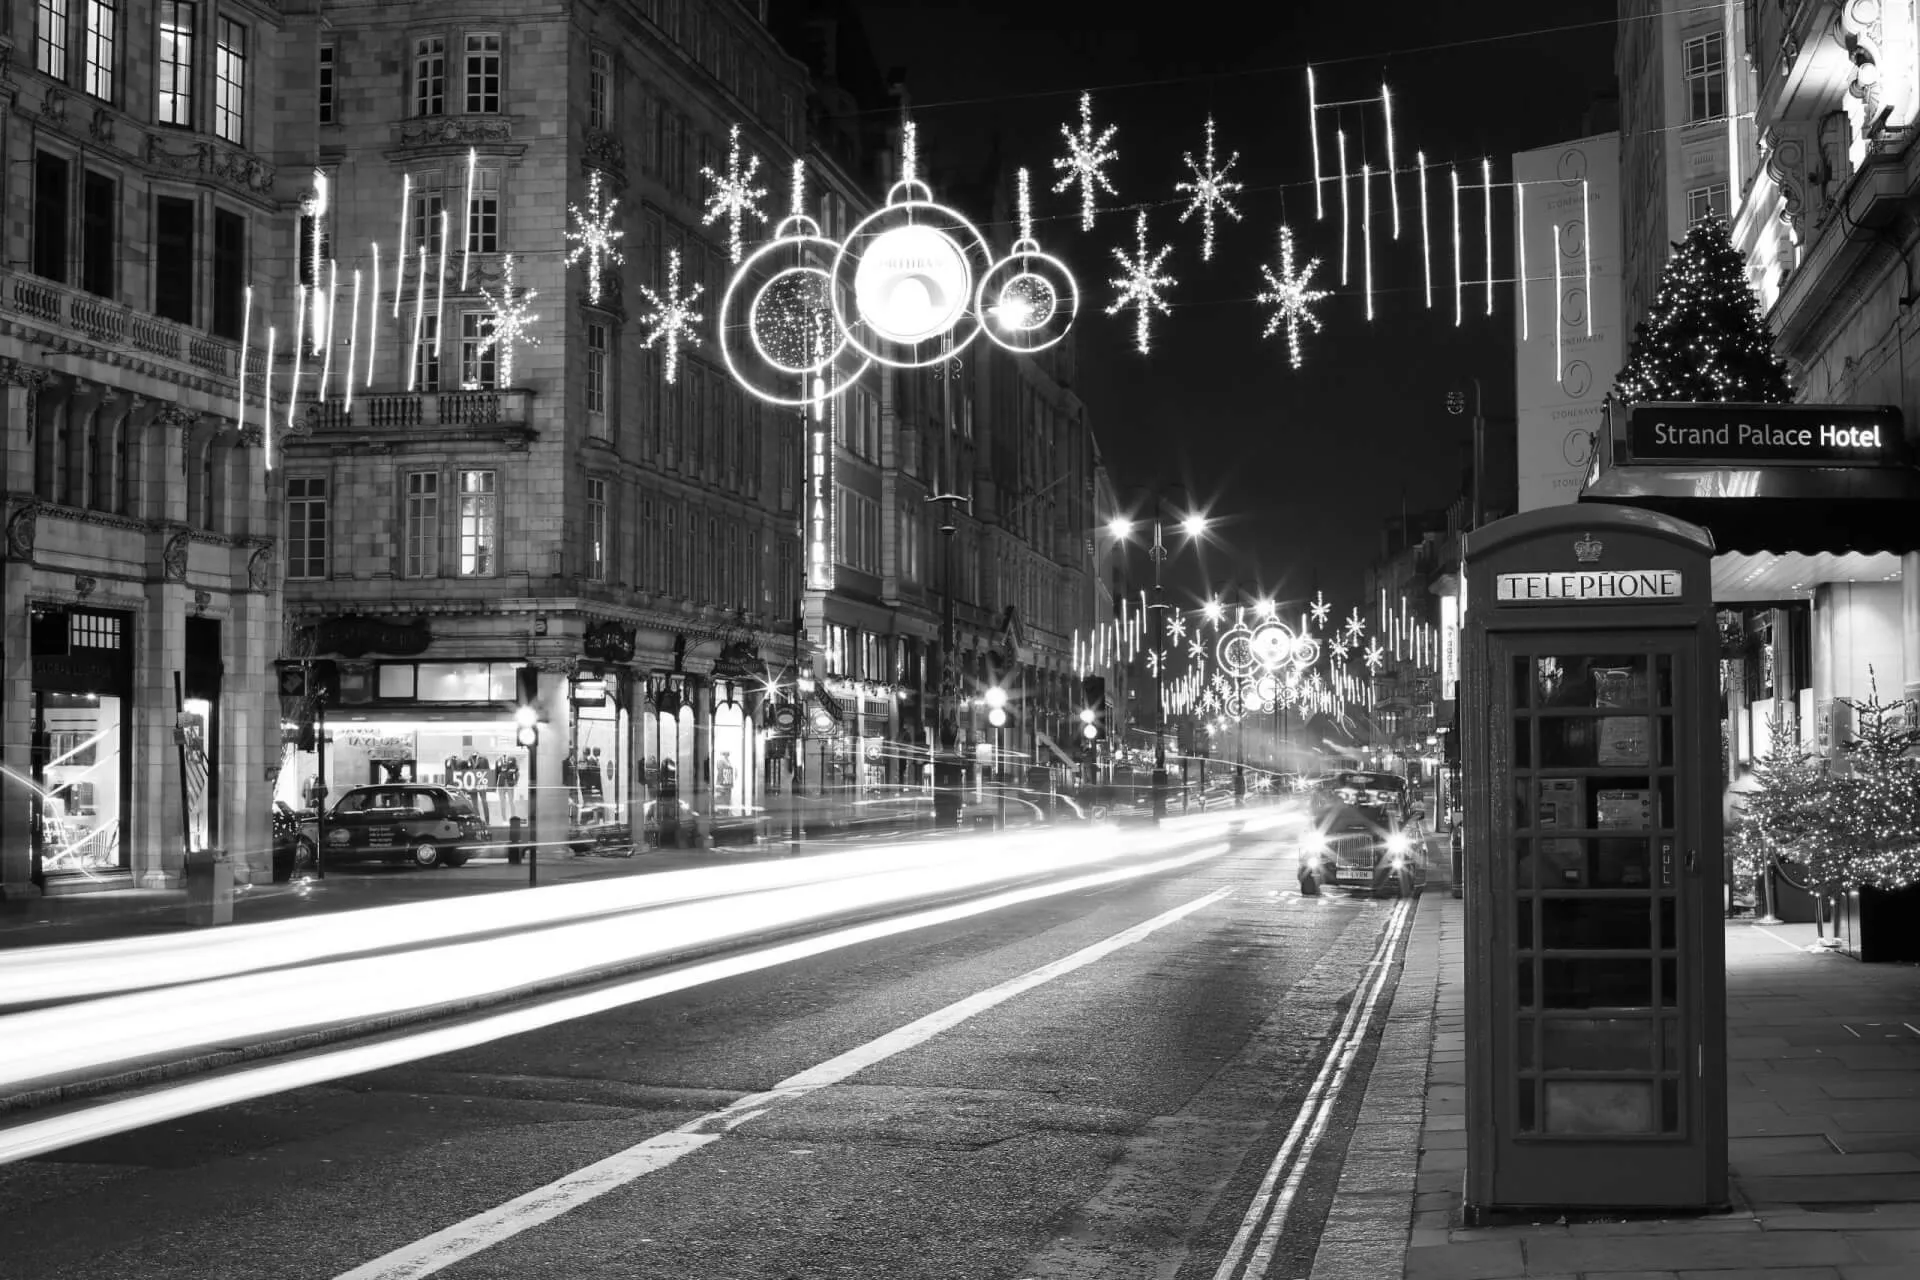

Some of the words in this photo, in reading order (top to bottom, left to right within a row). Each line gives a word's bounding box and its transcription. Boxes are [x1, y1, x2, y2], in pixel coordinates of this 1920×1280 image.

[1547, 191, 1601, 210] STONEHAEN
[1551, 405, 1599, 421] STONEHAVE
[1655, 423, 1729, 445] Strand
[1738, 423, 1812, 446] Palace
[1819, 424, 1882, 448] Hotel
[813, 432, 825, 586] THEATRE
[1505, 573, 1675, 599] TELEPHONE
[453, 770, 489, 790] 50%
[1663, 844, 1671, 885] PULL
